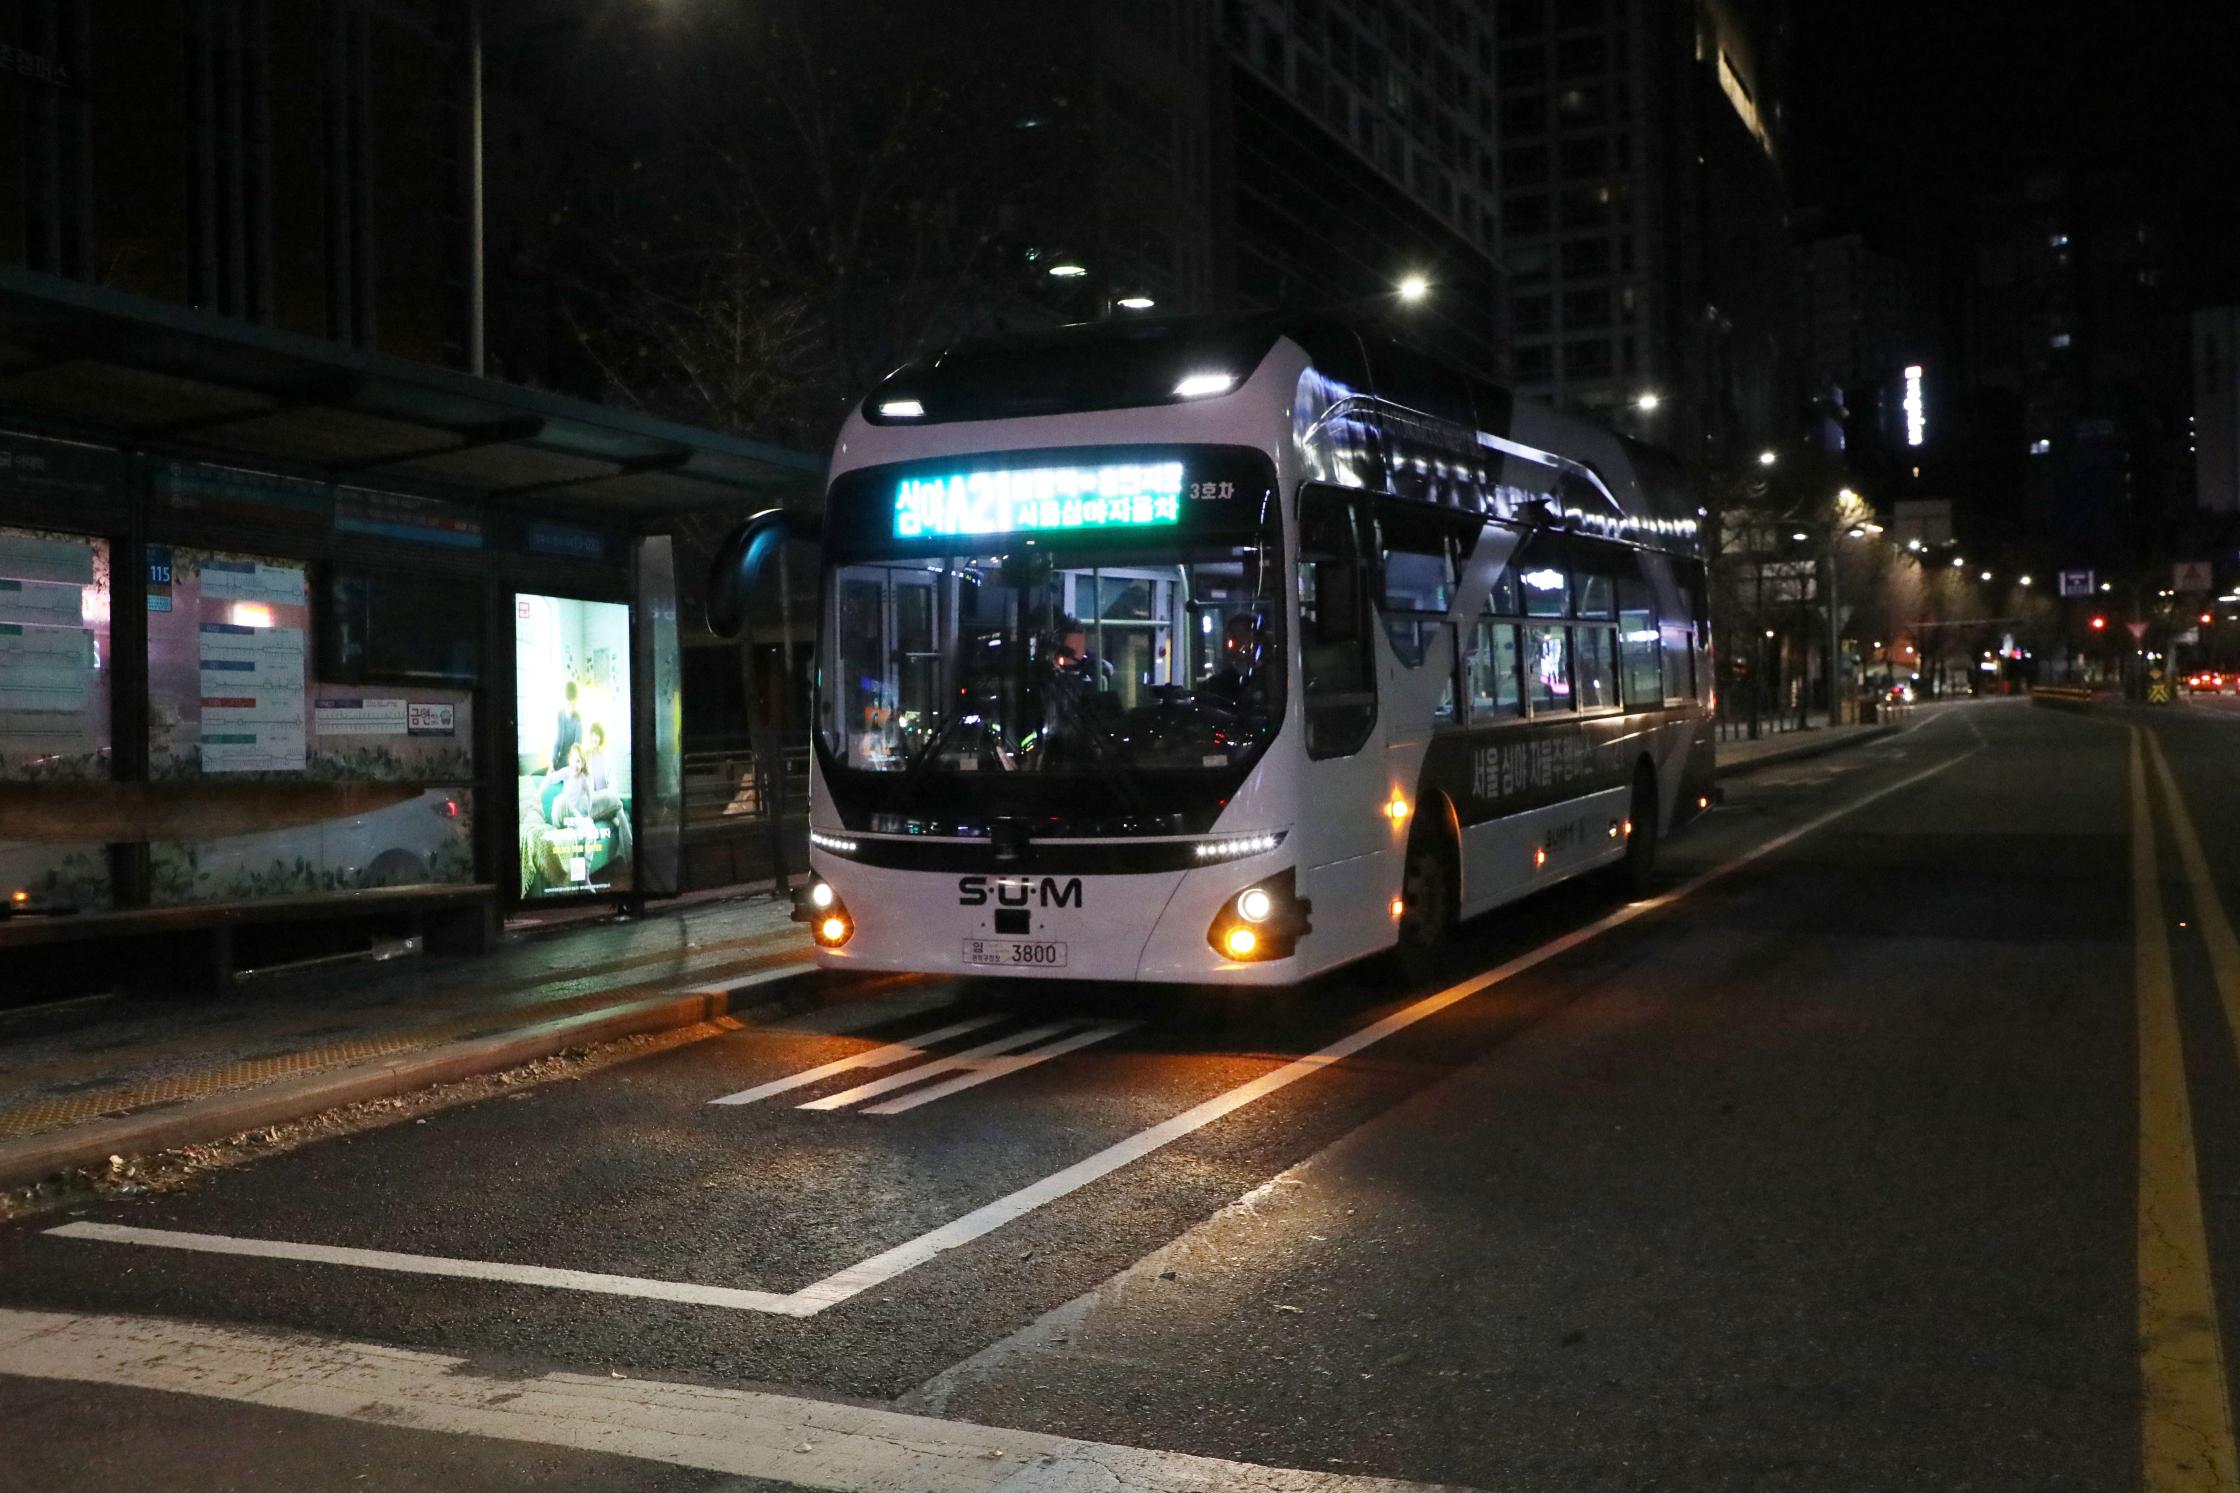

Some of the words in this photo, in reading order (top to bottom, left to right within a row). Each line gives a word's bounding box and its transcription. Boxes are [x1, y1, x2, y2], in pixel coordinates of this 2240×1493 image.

[1189, 481, 1235, 500] 3호차
[896, 479, 946, 536] 심야
[947, 472, 1011, 536] A21
[151, 565, 170, 582] 115
[1472, 746, 1499, 799] 서울
[1502, 743, 1528, 795] 심야
[1011, 944, 1057, 964] 3800
